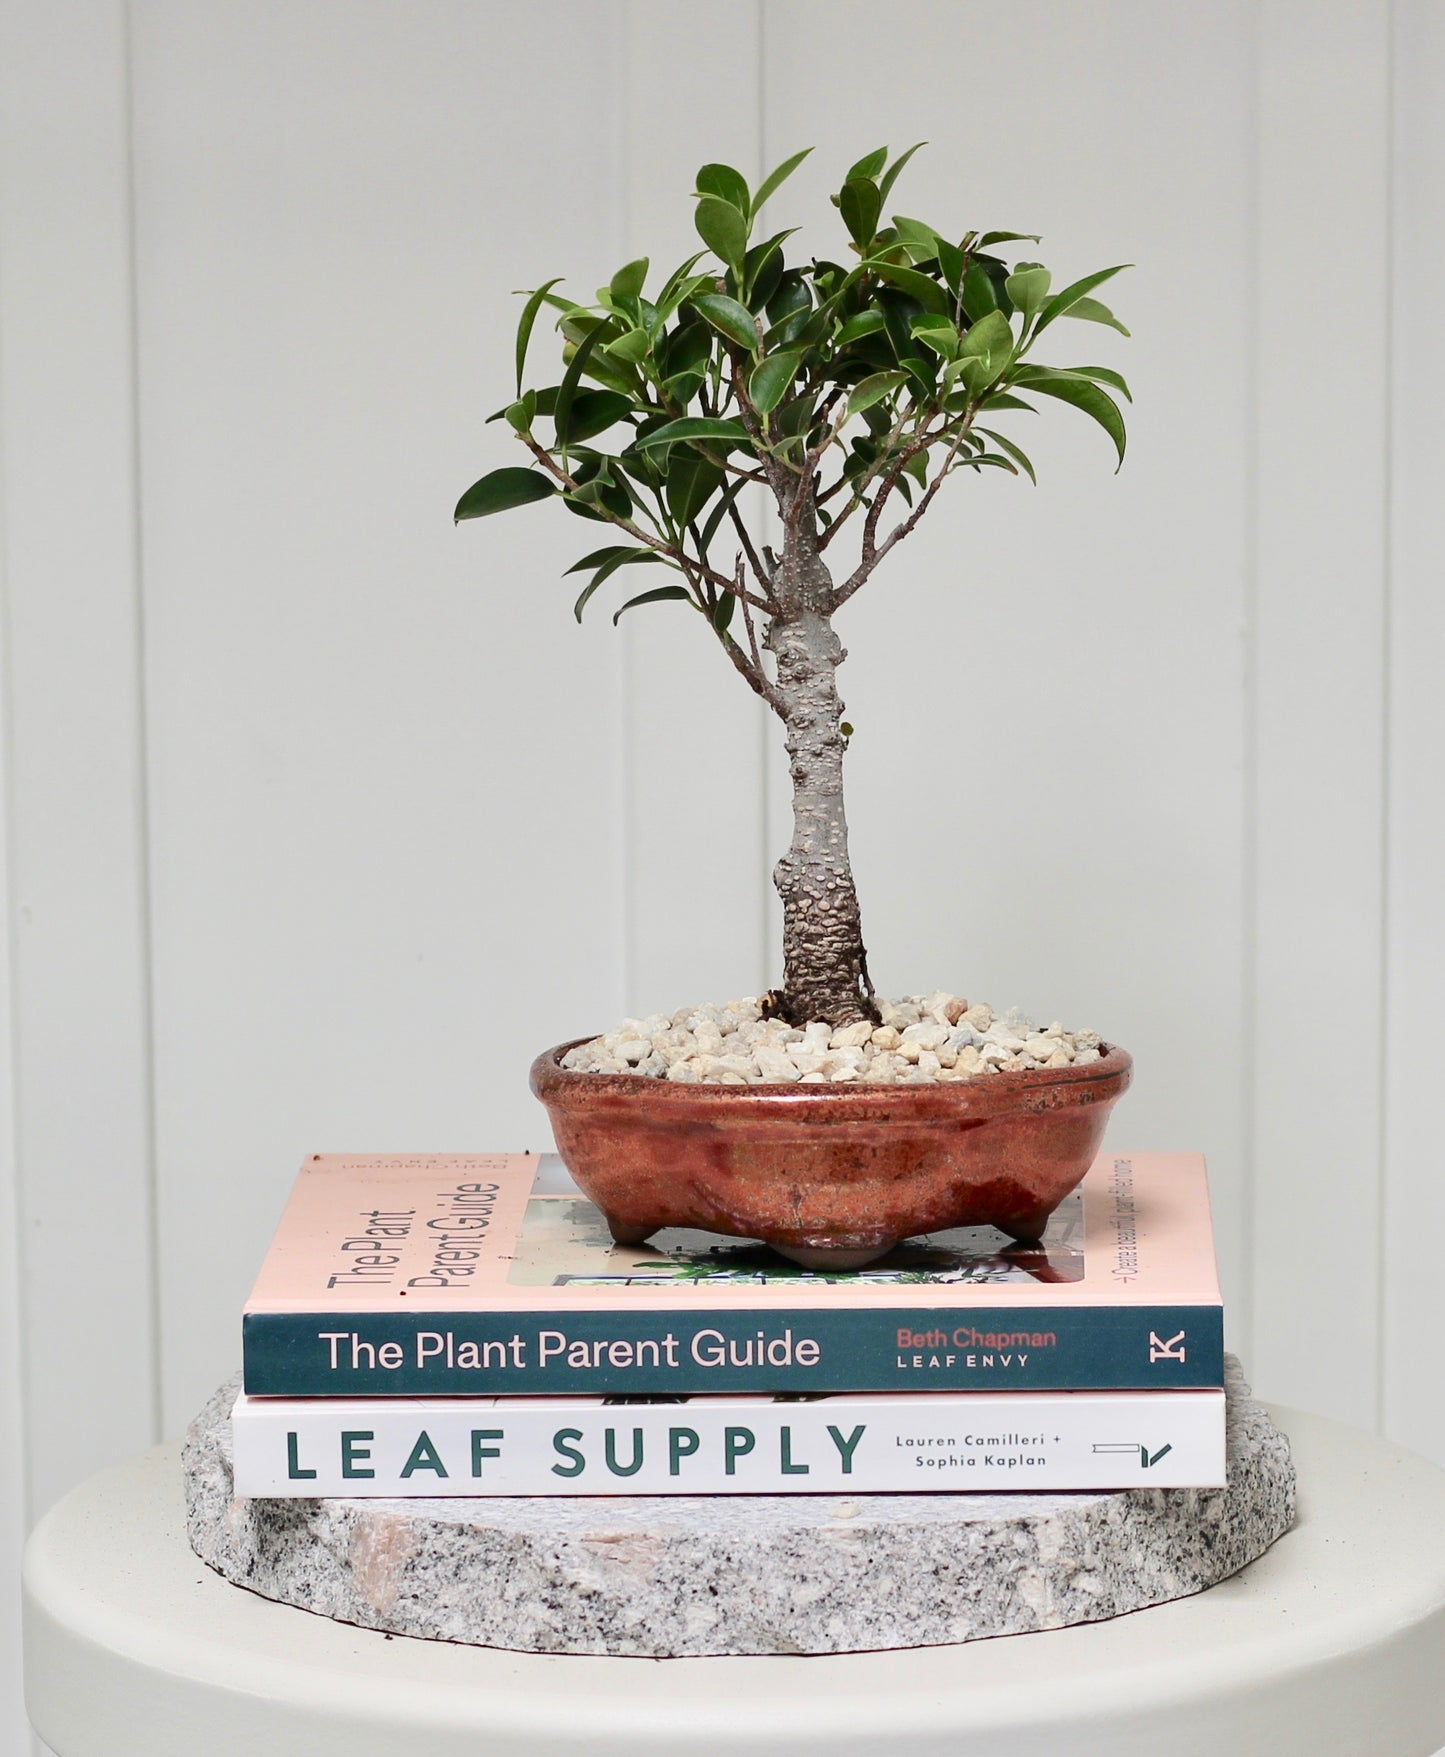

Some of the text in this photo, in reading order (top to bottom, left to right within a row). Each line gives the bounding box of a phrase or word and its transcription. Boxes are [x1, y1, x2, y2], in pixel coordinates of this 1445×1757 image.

[407, 1182, 500, 1288] Parent Guide
[327, 1210, 417, 1289] The Plant
[1111, 1251, 1138, 1275] Create
[318, 1328, 821, 1370] The Plant Parent Guide
[897, 1328, 1056, 1350] Beth Chapman
[1149, 1330, 1186, 1363] K
[897, 1354, 1029, 1368] LEAF ENVY
[286, 1424, 867, 1480] LEAF SUPPLY
[896, 1435, 956, 1447] Lauren
[964, 1433, 1045, 1446] Camilleri
[915, 1453, 1047, 1469] Sophia Kaplan
